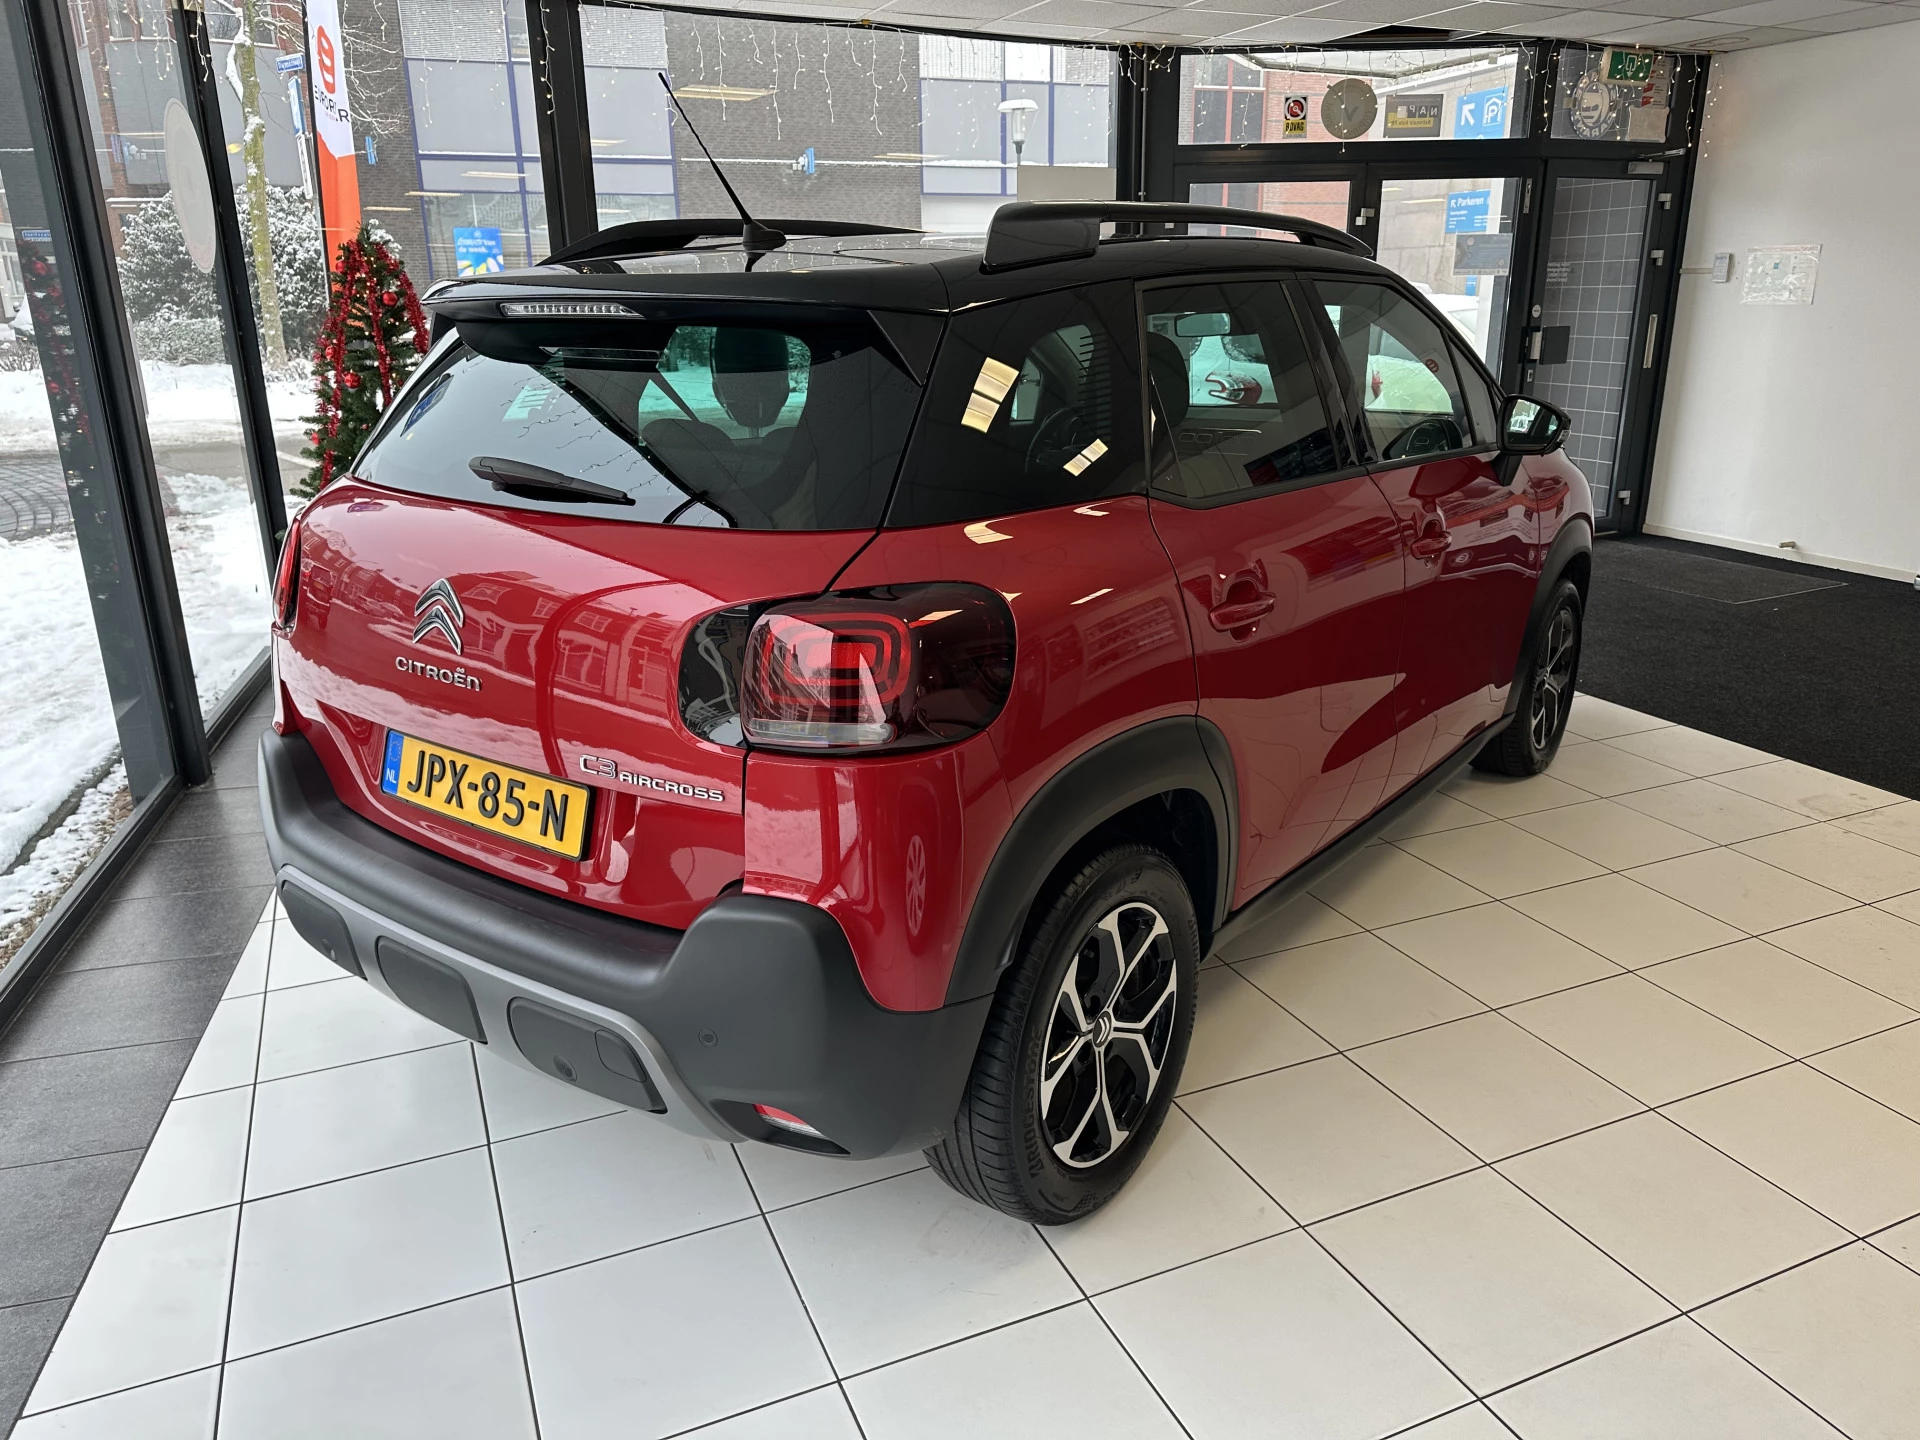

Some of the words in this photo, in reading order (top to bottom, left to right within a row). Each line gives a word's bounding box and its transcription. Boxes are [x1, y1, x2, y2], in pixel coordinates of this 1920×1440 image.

[1285, 121, 1305, 132] BOVAG
[1457, 196, 1484, 207] Parkeren
[386, 768, 397, 784] NL
[579, 754, 617, 780] C3
[619, 771, 725, 803] AIRCROSS
[406, 750, 569, 843] JPX-85-N
